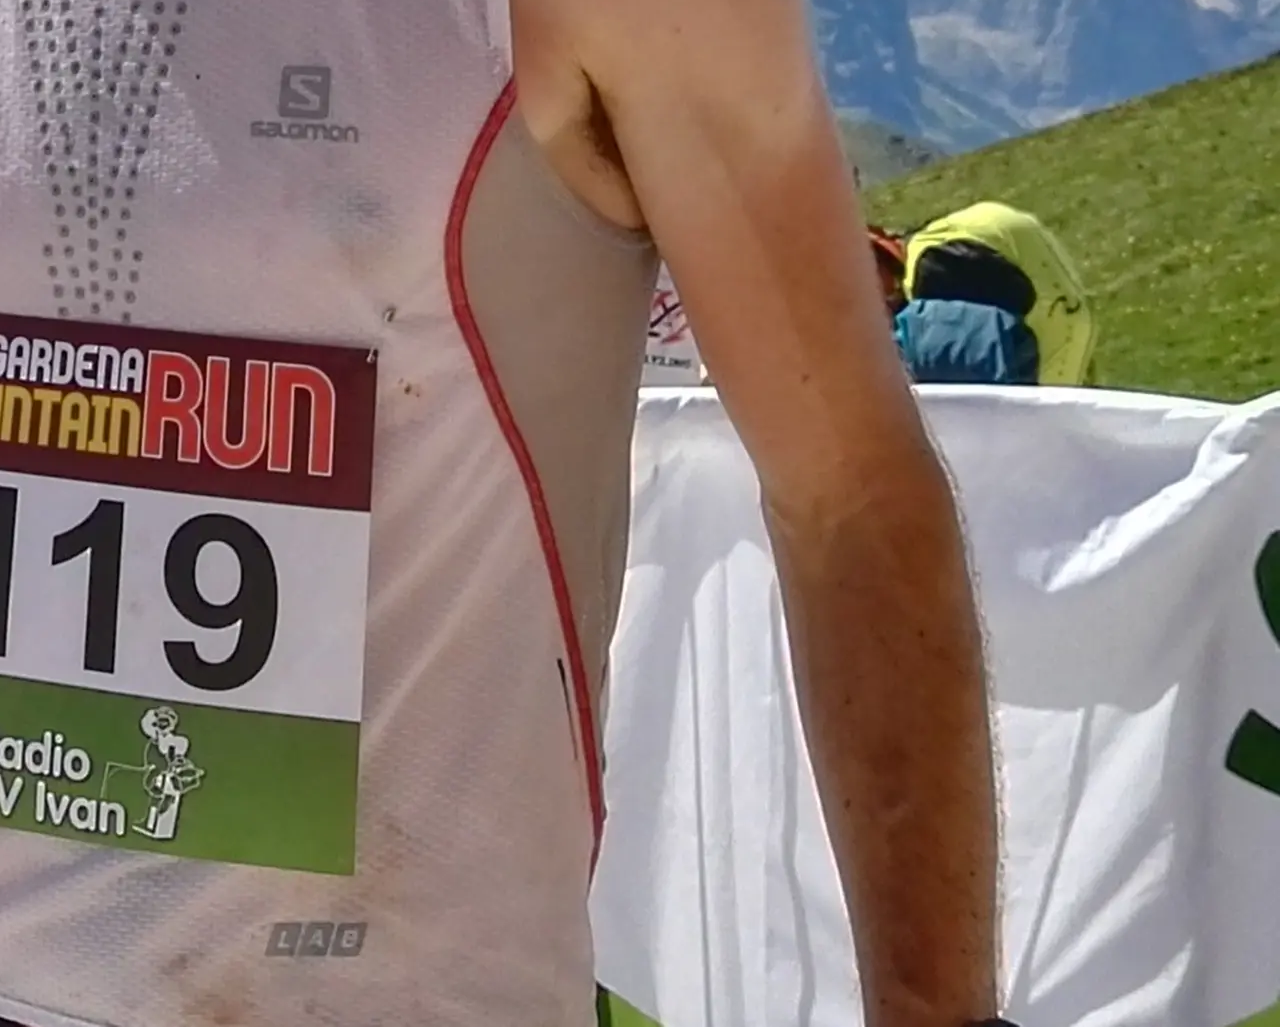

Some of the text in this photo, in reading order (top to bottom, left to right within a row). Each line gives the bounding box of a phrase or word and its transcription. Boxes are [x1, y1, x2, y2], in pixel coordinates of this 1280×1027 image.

[250, 121, 359, 143] salomon
[140, 349, 337, 477] RUN
[34, 781, 126, 836] Ivan
